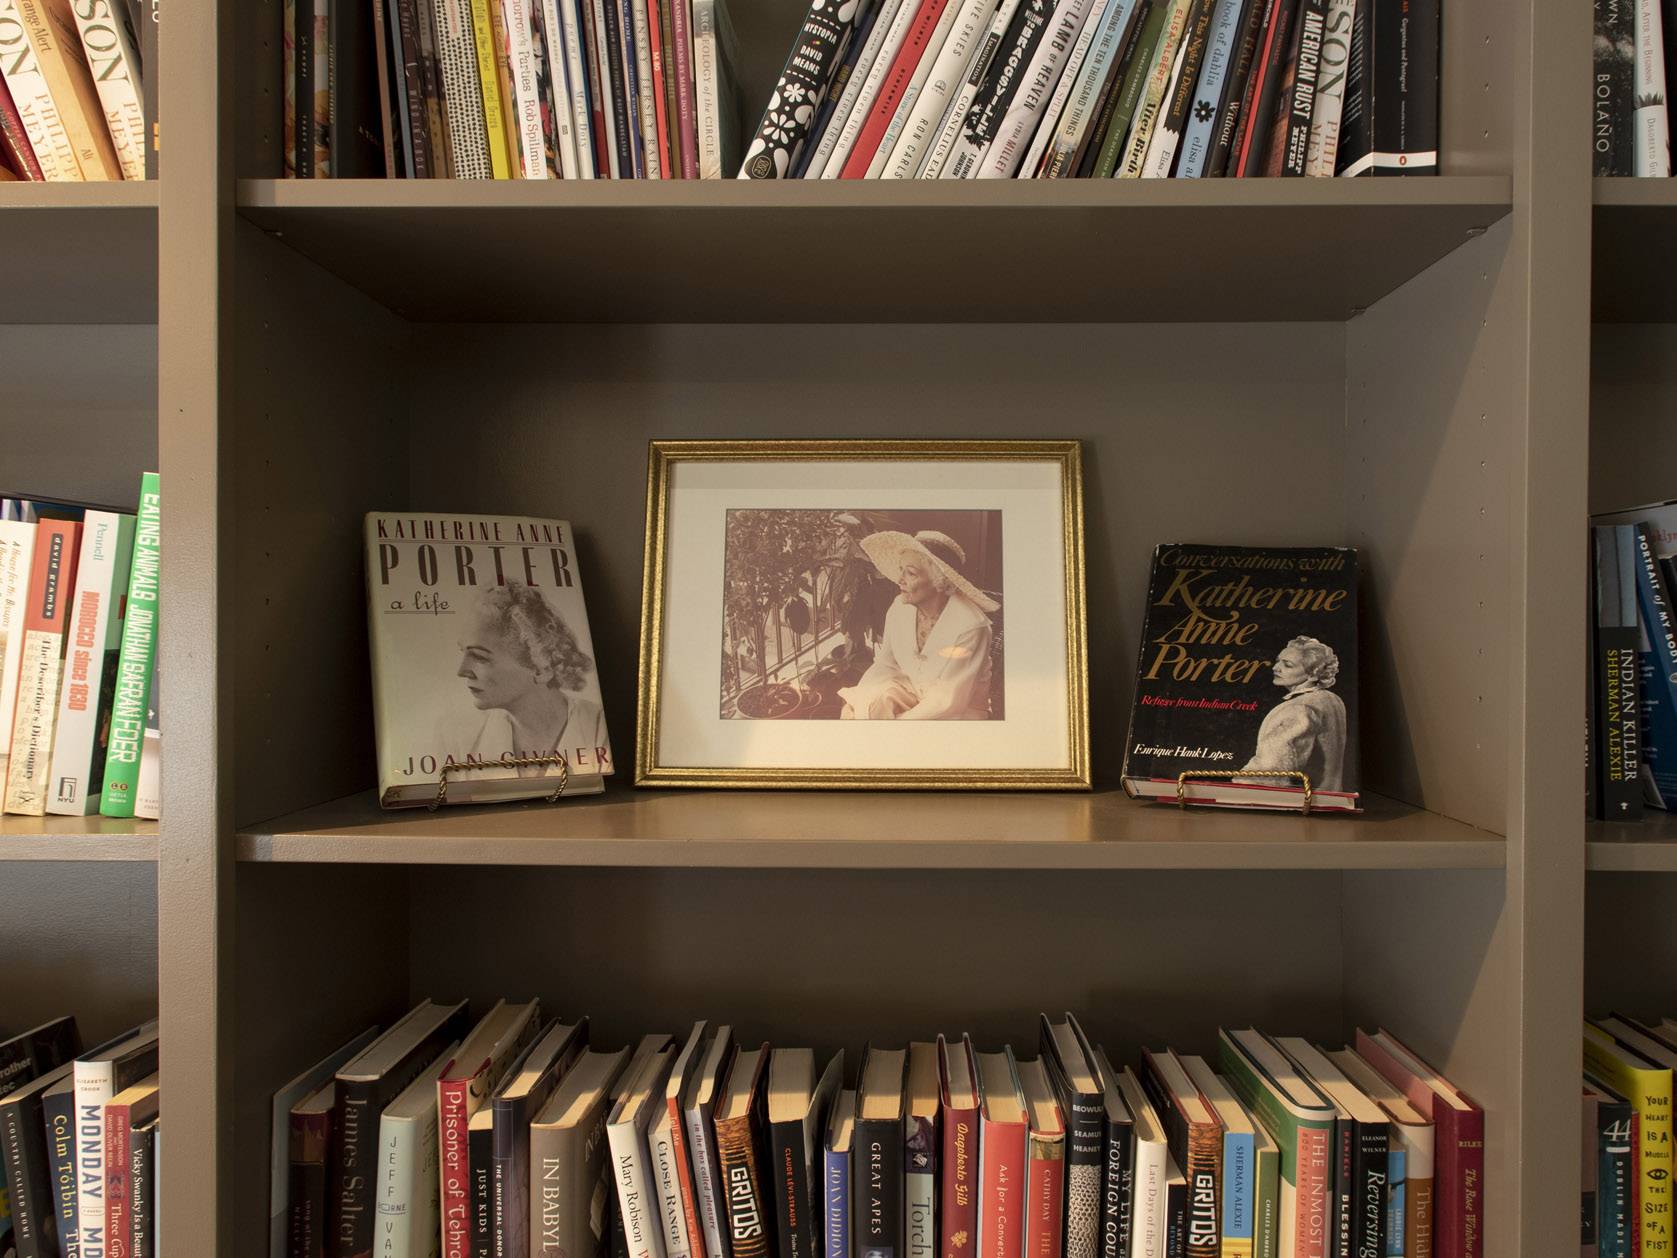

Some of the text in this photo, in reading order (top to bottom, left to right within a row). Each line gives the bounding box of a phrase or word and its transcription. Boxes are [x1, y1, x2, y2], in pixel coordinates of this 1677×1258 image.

[33, 28, 53, 54] Alert
[799, 44, 824, 62] DAVID
[803, 22, 838, 45] HYSTOPIA
[953, 23, 974, 57] SKIES
[1023, 10, 1080, 112] LAMB HEAVEN
[1157, 8, 1183, 82] ELISA ALBERT
[1206, 1, 1235, 86] book of dahlia
[1316, 11, 1351, 105] SON
[679, 72, 687, 95] MARK
[792, 56, 820, 75] MEANS
[975, 25, 1034, 136] BRAGGSVILLE
[1065, 3, 1124, 137] AMONG THE TEN THOUSAND THINGS
[1173, 15, 1210, 117] This Night Different
[1293, 11, 1324, 120] AMERICAN RUST
[18, 104, 58, 179] MEYER
[35, 94, 78, 178] PHILIPP
[519, 51, 539, 177] Parties Rob Spillman
[702, 117, 714, 157] CIRCLE
[913, 118, 929, 141] RON
[936, 95, 970, 160] CORNELIUS
[1219, 101, 1240, 147] Without
[1595, 74, 1613, 153] BOLAÑO
[81, 148, 95, 160] Ali
[952, 152, 967, 178] JOHNSON
[994, 140, 1017, 174] MILLET
[1128, 137, 1146, 174] Birth
[1157, 150, 1170, 171] Elisa
[1188, 136, 1202, 165] elisa
[1296, 126, 1308, 174] PHILIPP
[93, 522, 108, 561] Pennell
[137, 493, 160, 547] EATING
[377, 519, 565, 544] KATHERINE ANNE
[46, 536, 62, 618] david grambs
[378, 543, 574, 588] PORTER
[1153, 567, 1348, 612] Katherine
[1160, 548, 1346, 572] Conversations with
[1637, 535, 1672, 629] PORTRAIT of MY
[75, 591, 101, 649] MOROCCO
[390, 591, 450, 616] a life
[1152, 608, 1260, 646] Anne
[122, 604, 154, 663] JONATHAN
[1143, 643, 1272, 685] Porter
[24, 639, 52, 782] The Describer's Dictionary
[1141, 694, 1258, 713] Refugee from Indian Creek
[1606, 649, 1623, 782] SHERMAN ALEXIE
[1620, 649, 1638, 782] INDIAN KILLER
[109, 718, 142, 763] FOER
[402, 746, 611, 776] JOAN GIVNER
[1133, 743, 1234, 761] Enrique Hank Lopez
[1645, 1095, 1669, 1106] YOUR
[80, 1105, 103, 1199] MONDAY
[446, 1090, 465, 1198] Prisoner of
[1603, 1119, 1631, 1142] 44
[1647, 1131, 1668, 1143] IS A
[9, 1122, 30, 1239] COUNTRY CALLED HOME
[53, 1114, 81, 1258] Colm Tóibín The
[131, 1148, 145, 1225] Vicky Swanky Is
[340, 1095, 368, 1247] James Salter
[542, 1157, 560, 1181] IN
[784, 1147, 793, 1178] CLAUDE
[871, 1142, 881, 1235] GREAT APES
[954, 1123, 969, 1206] Dagoberto Gilb
[996, 1164, 1009, 1201] Ask for
[1107, 1138, 1121, 1216] FOREIGN
[1233, 1145, 1243, 1230] SHERMAN ALEXIE
[1309, 1134, 1325, 1246] THE INMOST
[111, 1204, 122, 1236] Three
[476, 1168, 488, 1234] JUST KIDS
[620, 1154, 643, 1243] Mary Robison
[657, 1140, 681, 1246] CLOSE RANGE
[699, 1165, 716, 1229] called pleasure
[731, 1167, 764, 1240] GRITOS
[831, 1167, 843, 1257] JOAN DIDION
[1039, 1169, 1052, 1256] CATHY DAY THE
[1119, 1170, 1132, 1242] MY LIFE
[1145, 1164, 1159, 1245] Last Days of the
[1188, 1174, 1218, 1247] GRITOS
[1416, 1188, 1430, 1220] The
[1464, 1168, 1477, 1249] The Rose Window
[1616, 1160, 1624, 1244] DUBLIN MADE
[1645, 1201, 1668, 1214] SIZE
[496, 1229, 504, 1257] DONOR
[911, 1196, 932, 1255] Torch
[1645, 1240, 1669, 1250] FIST
[1658, 1224, 1666, 1234] A
